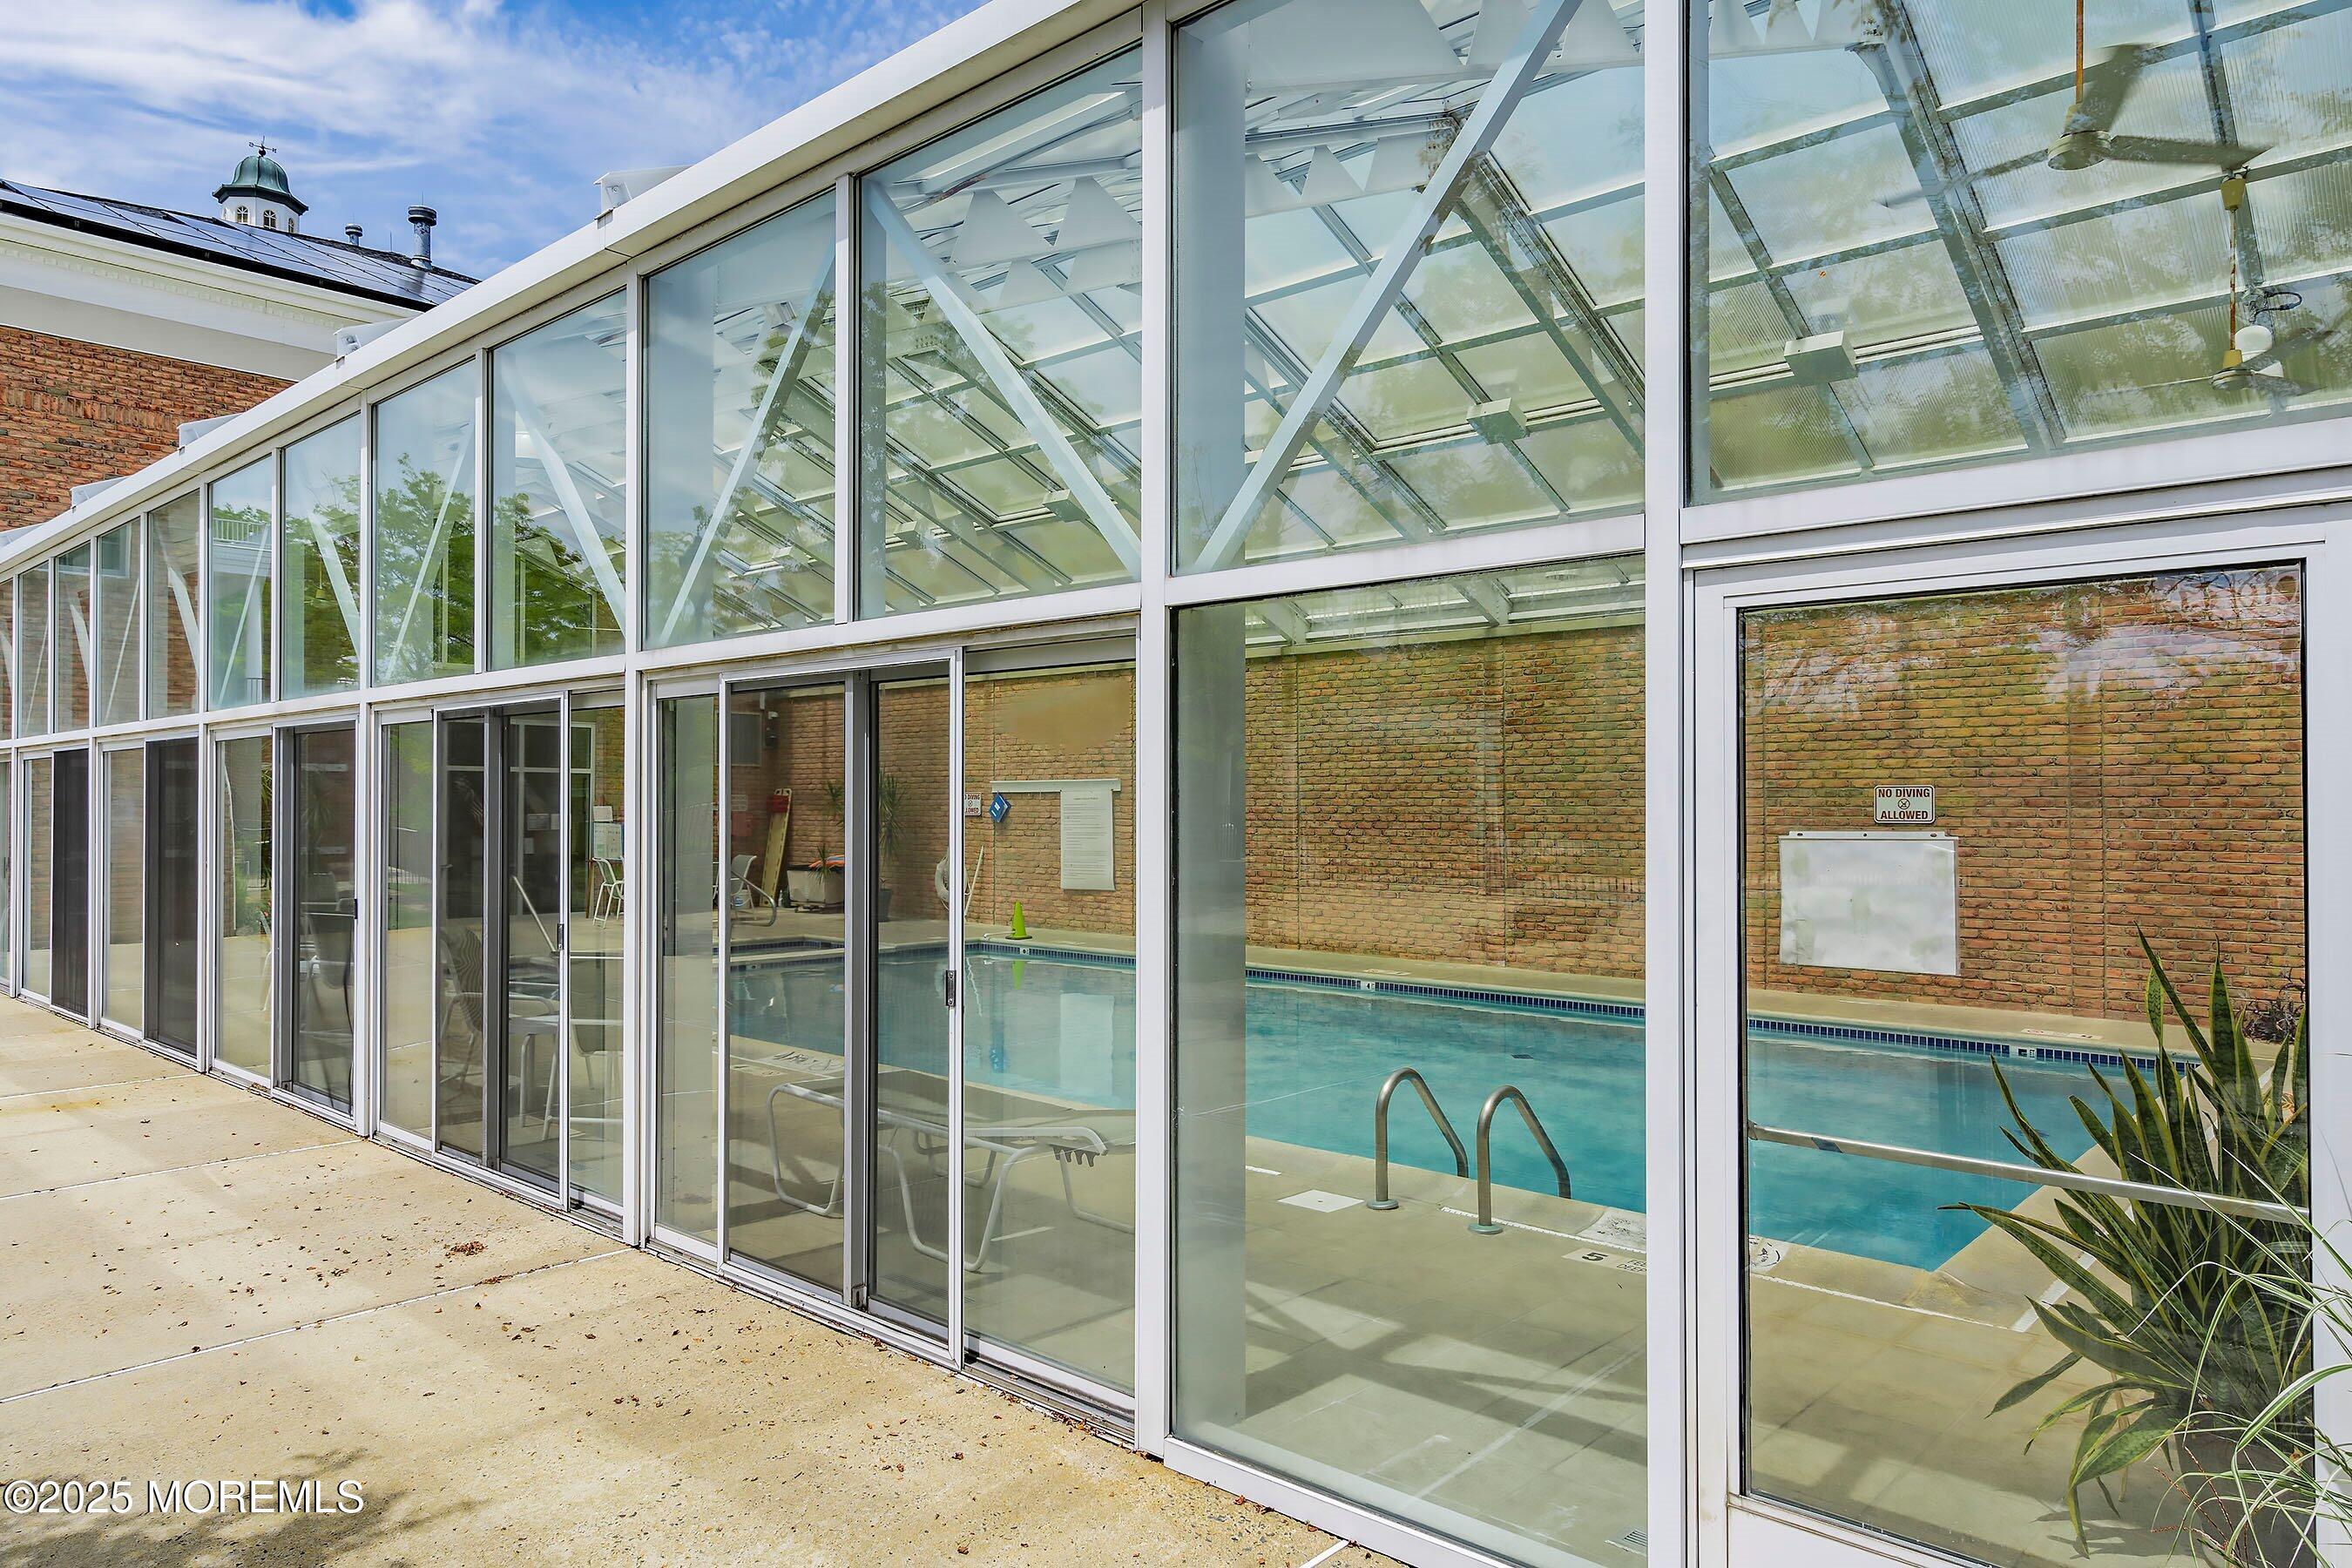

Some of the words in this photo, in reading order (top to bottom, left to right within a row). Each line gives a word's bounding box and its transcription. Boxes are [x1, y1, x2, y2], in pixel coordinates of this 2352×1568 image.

[1878, 788, 1892, 798] NO
[1896, 788, 1930, 798] DIVING
[1880, 810, 1929, 820] ALLOWED
[1581, 1252, 1609, 1262] 5
